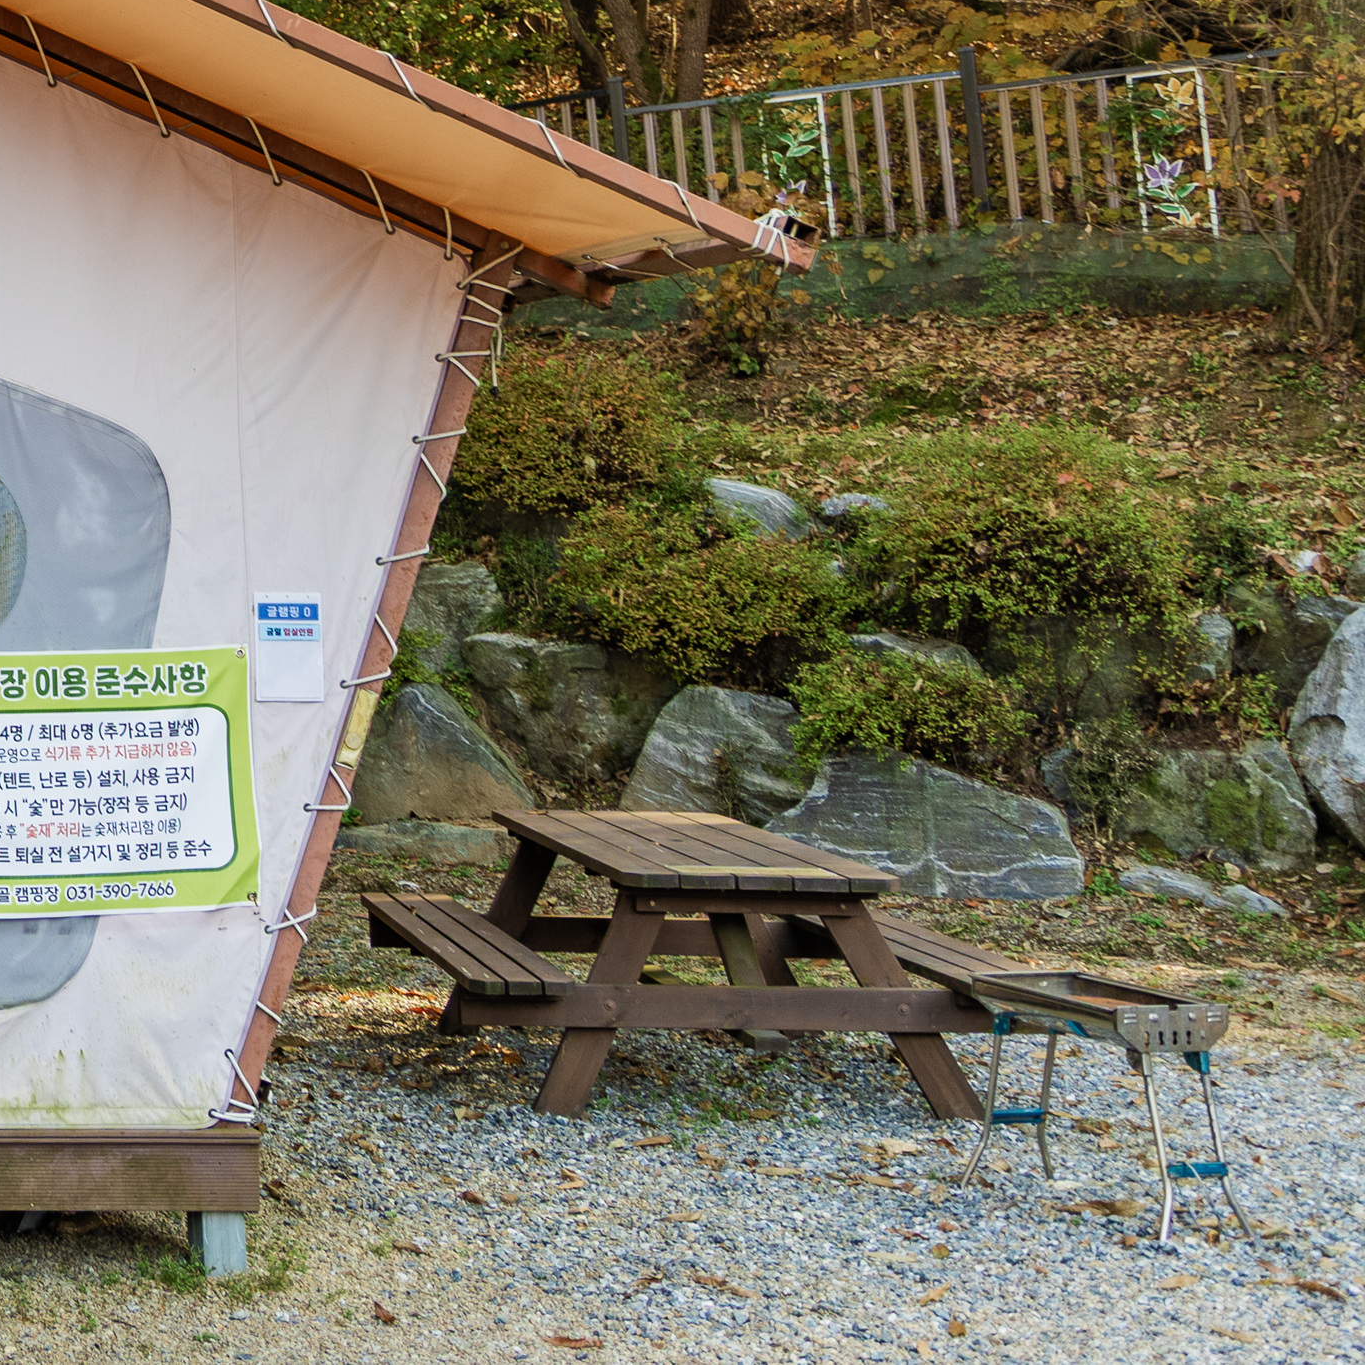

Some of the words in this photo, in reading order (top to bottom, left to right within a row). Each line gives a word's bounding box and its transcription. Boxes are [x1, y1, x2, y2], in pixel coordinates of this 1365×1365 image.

[266, 605, 300, 618] 글램핑
[303, 605, 311, 618] 0
[34, 666, 88, 699] 이용
[94, 663, 207, 697] 준수사항
[0, 724, 23, 742] 4명
[27, 724, 34, 741] /
[38, 723, 67, 741] 최대
[71, 722, 94, 741] 6명
[98, 720, 164, 740] (추가요금
[168, 717, 200, 738] 발생)
[44, 745, 82, 761] 식기류
[85, 744, 111, 760] 추가
[114, 743, 164, 759] 지급하지
[166, 740, 197, 757] 않음)
[39, 771, 68, 789] 난로
[72, 769, 92, 788] 등)
[97, 769, 129, 788] 설치,
[132, 767, 160, 786] 사용
[164, 765, 195, 784] 금지
[4, 799, 18, 817] 시
[68, 796, 131, 816] 가능(장작
[134, 795, 150, 814] 등
[154, 792, 188, 812] 금지)
[5, 824, 17, 840] 후
[94, 821, 155, 837] 숯재처리함
[157, 817, 182, 834] 이용)
[15, 846, 44, 864] 퇴실
[48, 845, 63, 864] 전
[67, 844, 112, 863] 설거지
[116, 843, 131, 861] 및
[135, 841, 163, 861] 정리
[166, 840, 179, 859] 등
[183, 839, 212, 857] 준수
[15, 885, 59, 903] 캠핑장
[66, 882, 174, 901] 031-390-7666
